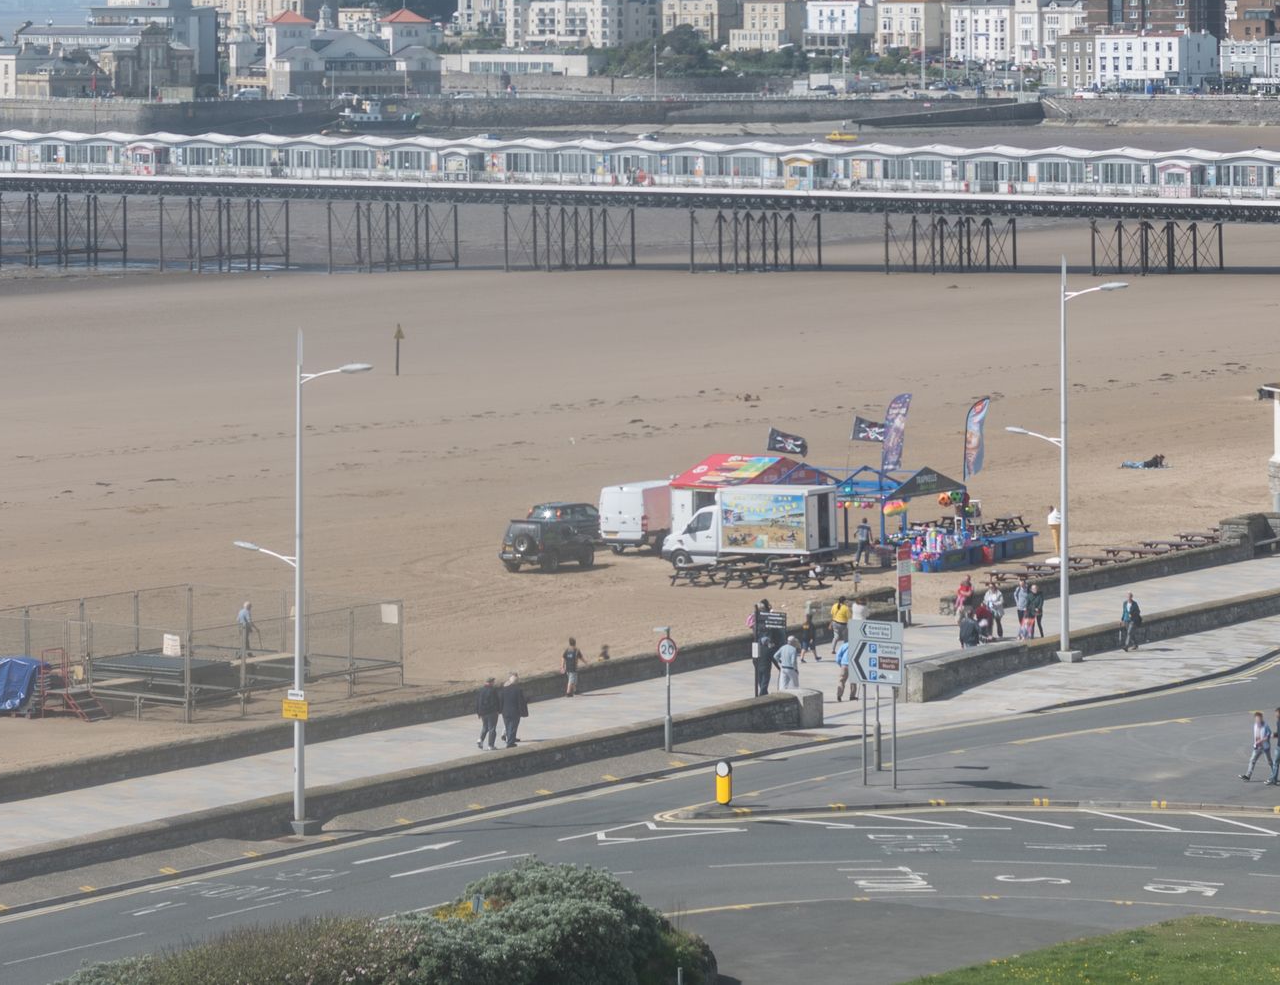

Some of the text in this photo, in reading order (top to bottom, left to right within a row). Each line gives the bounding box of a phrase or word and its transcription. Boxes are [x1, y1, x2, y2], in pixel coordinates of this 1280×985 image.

[661, 644, 674, 655] 20
[995, 875, 1071, 884] S
[1143, 878, 1224, 897] M5
